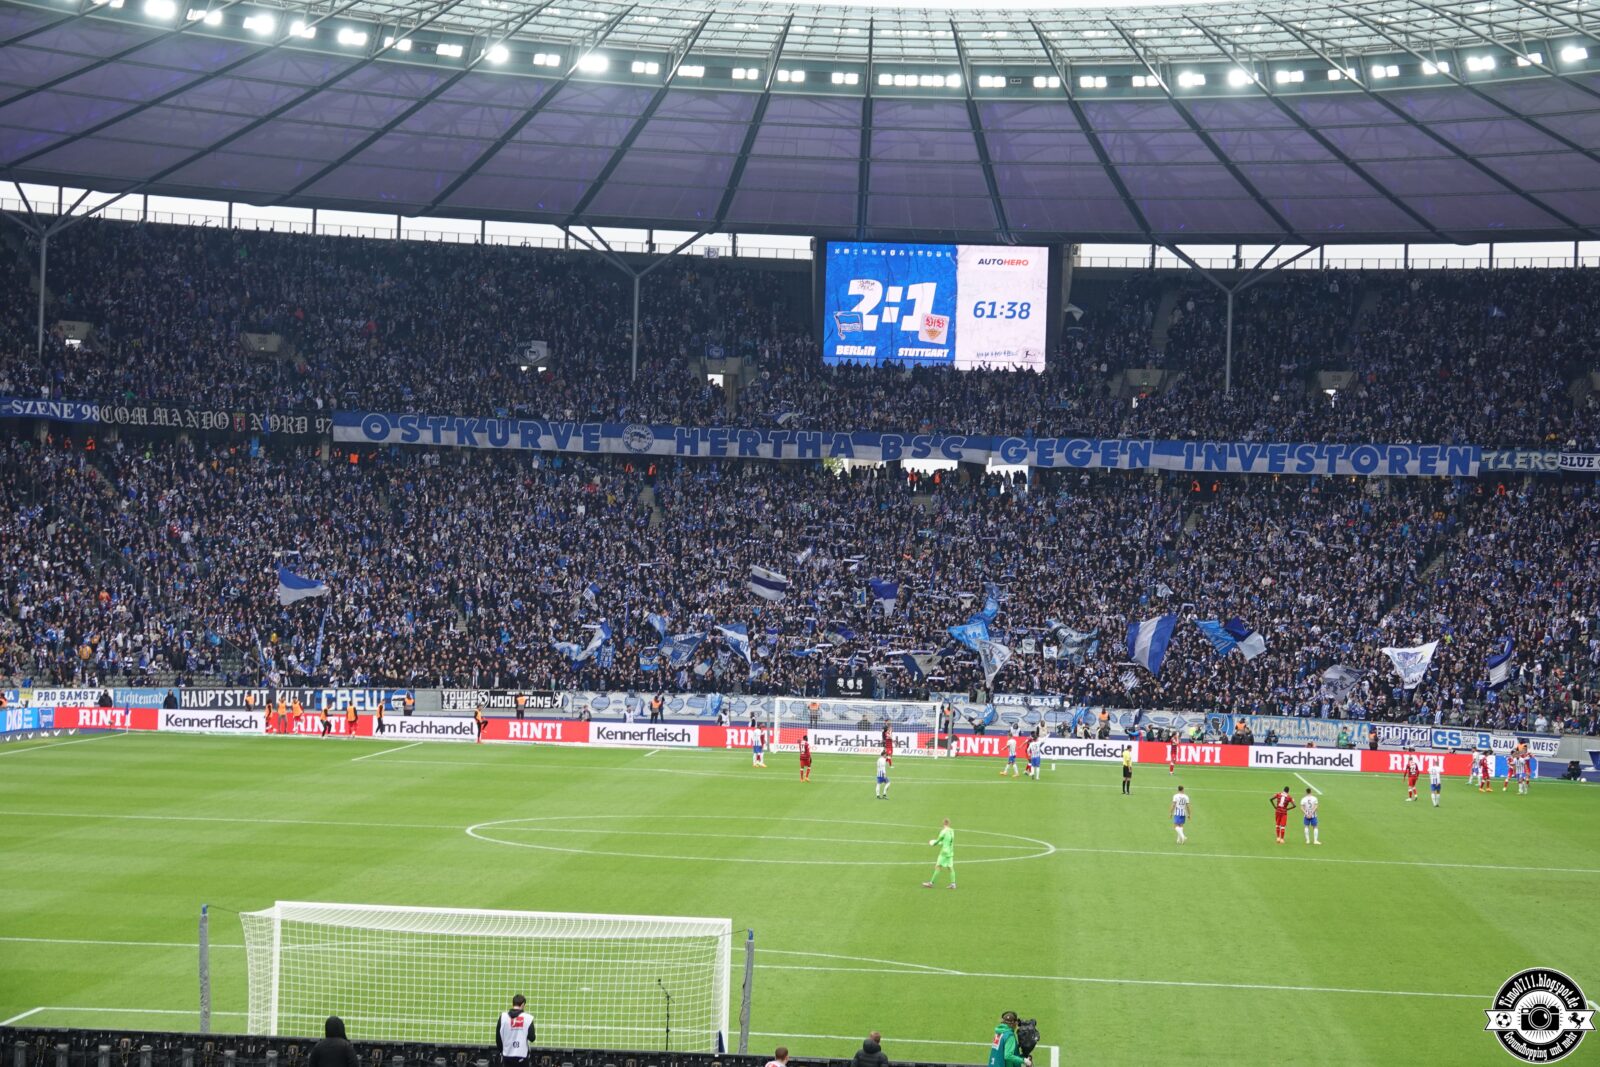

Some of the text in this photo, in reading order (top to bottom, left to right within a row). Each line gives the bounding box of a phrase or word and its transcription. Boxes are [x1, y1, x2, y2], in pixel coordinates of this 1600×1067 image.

[978, 258, 1029, 266] AUTOHERO
[973, 301, 1031, 319] 61:38
[835, 345, 876, 356] BERLIN
[898, 347, 949, 357] STUTTGART
[11, 399, 75, 419] SZENE
[100, 404, 229, 430] COMMANDO
[361, 413, 602, 452] OSTKURVE
[673, 427, 857, 459] HERTHA
[879, 432, 967, 461] BSC
[999, 437, 1155, 469] GEGEN
[1183, 442, 1471, 476] INVESTOREN
[1560, 456, 1594, 468] BLUE
[37, 691, 102, 701] PRO SAMSTA
[115, 690, 167, 705] Lichtenrad
[490, 696, 551, 708] HOOLGANS
[78, 709, 131, 726] RINTI
[165, 714, 258, 729] Kennerfleisch
[400, 720, 474, 735] Fachhandel
[508, 721, 562, 739] RINTI
[597, 726, 691, 742] Kennerfleisch
[835, 735, 909, 748] Fachhadel
[957, 737, 1000, 754] INTI
[1493, 739, 1514, 749] BLAU
[1532, 741, 1559, 751] WEISS
[1255, 750, 1353, 767] Im Fachhandel
